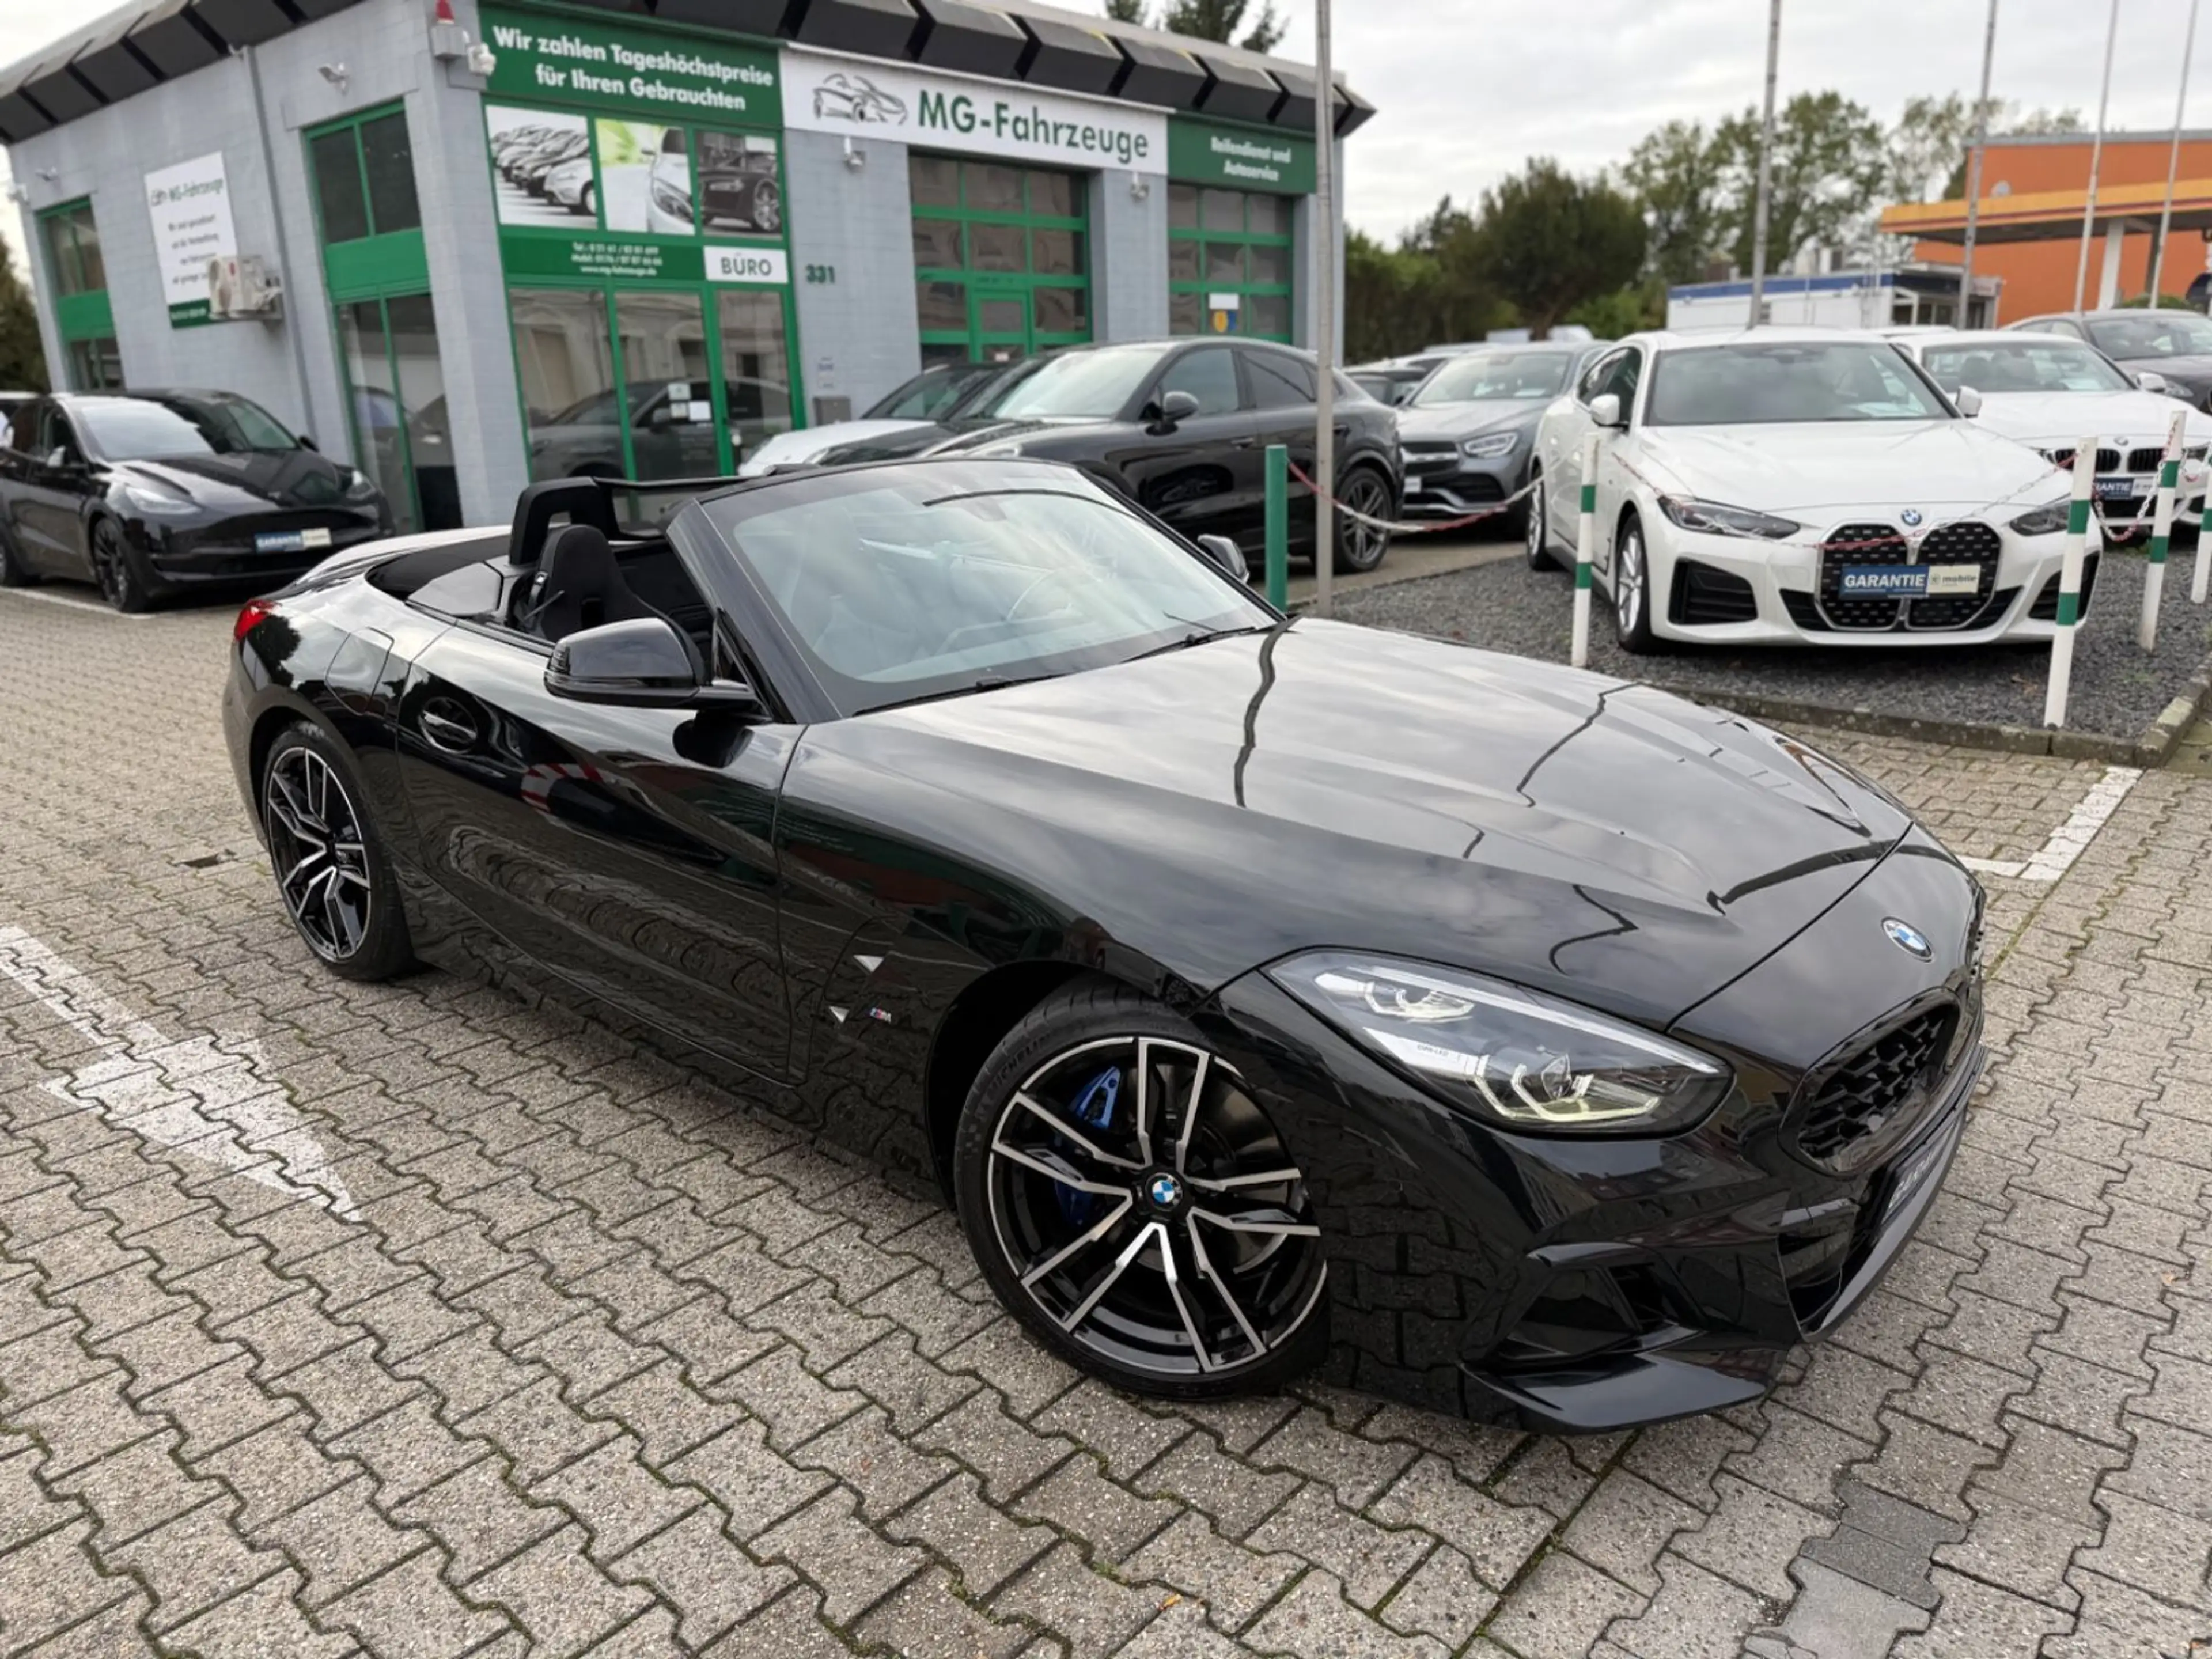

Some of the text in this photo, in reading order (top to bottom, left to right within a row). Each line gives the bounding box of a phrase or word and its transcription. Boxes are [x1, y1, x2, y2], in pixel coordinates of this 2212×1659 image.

[493, 26, 774, 86] Wir zahlen Tageshöchstpreise
[536, 63, 745, 111] für Ihren Gebrauchten
[918, 90, 1148, 165] MG-Fahrzeuge
[721, 252, 772, 276] BÜRO
[805, 263, 835, 284] 331
[1845, 574, 1926, 588] GARANTIE
